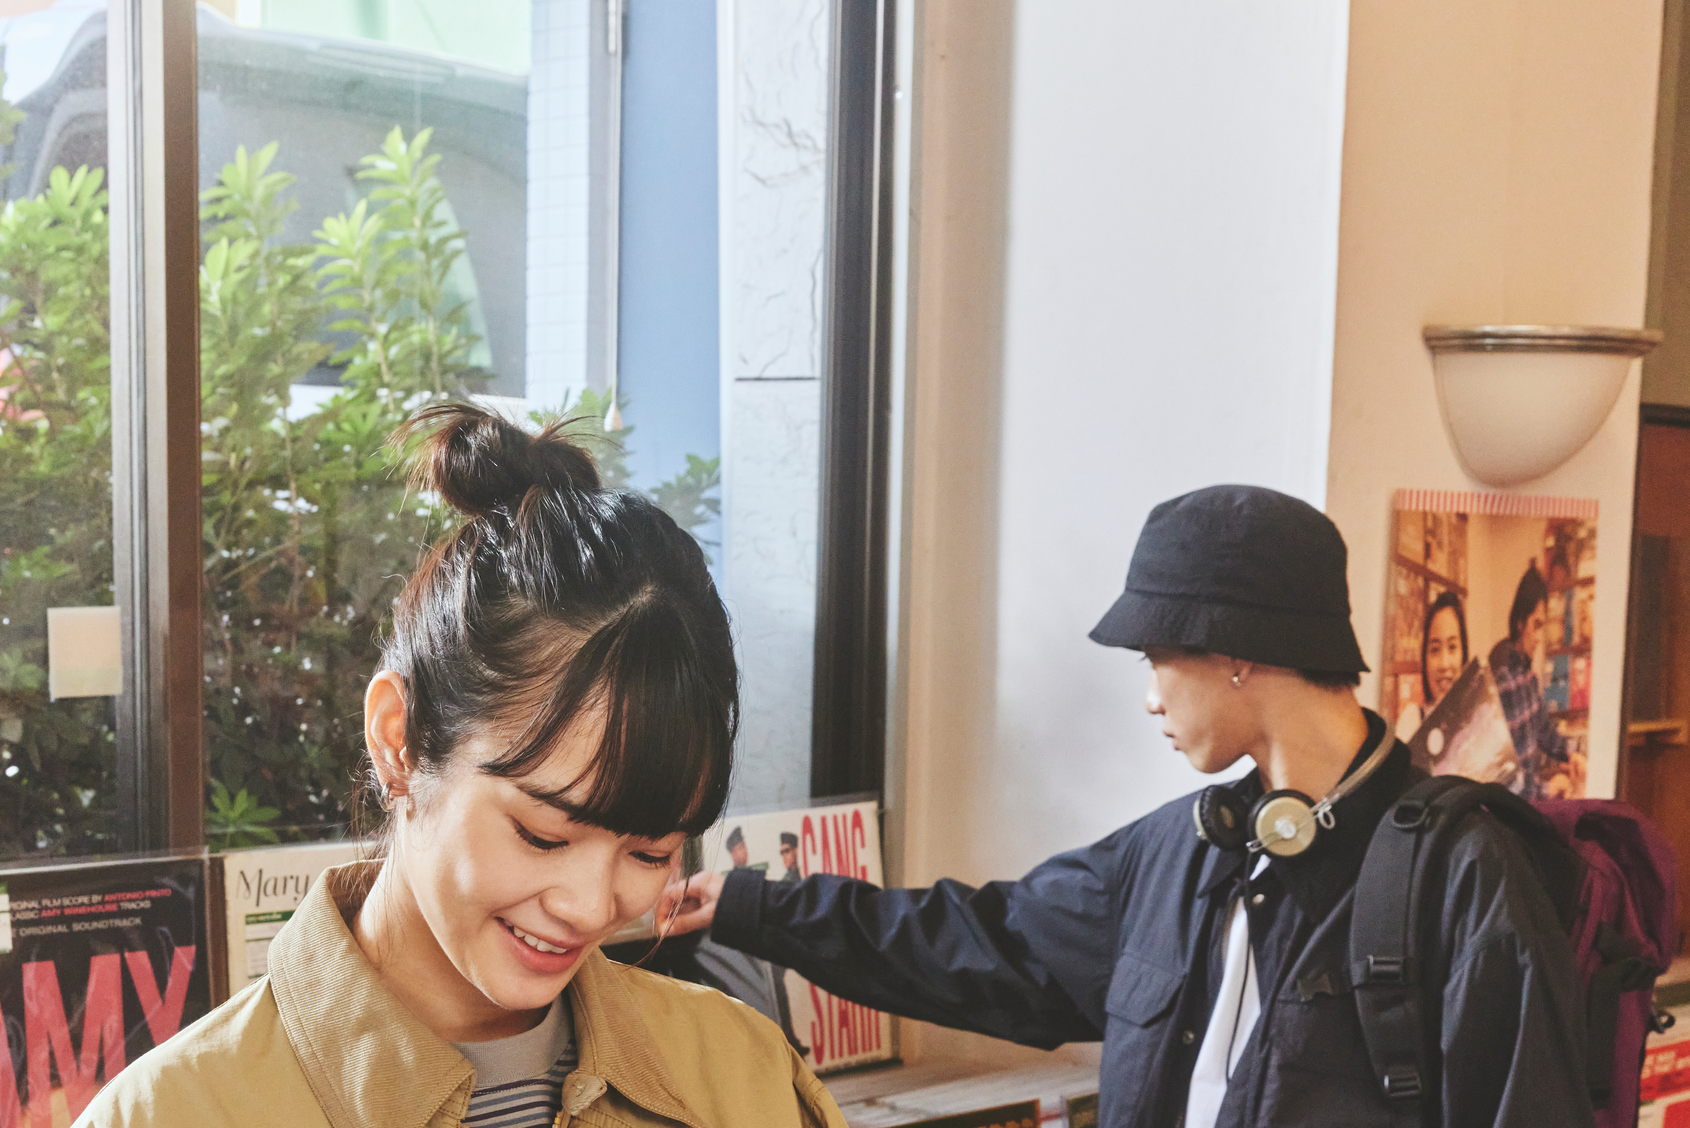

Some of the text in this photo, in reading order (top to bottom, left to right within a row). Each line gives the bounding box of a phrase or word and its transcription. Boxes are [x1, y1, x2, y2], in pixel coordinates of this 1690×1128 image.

[236, 868, 309, 907] Mary
[20, 924, 69, 936] ORIGINAL
[72, 916, 142, 932] SOUNDTRACK
